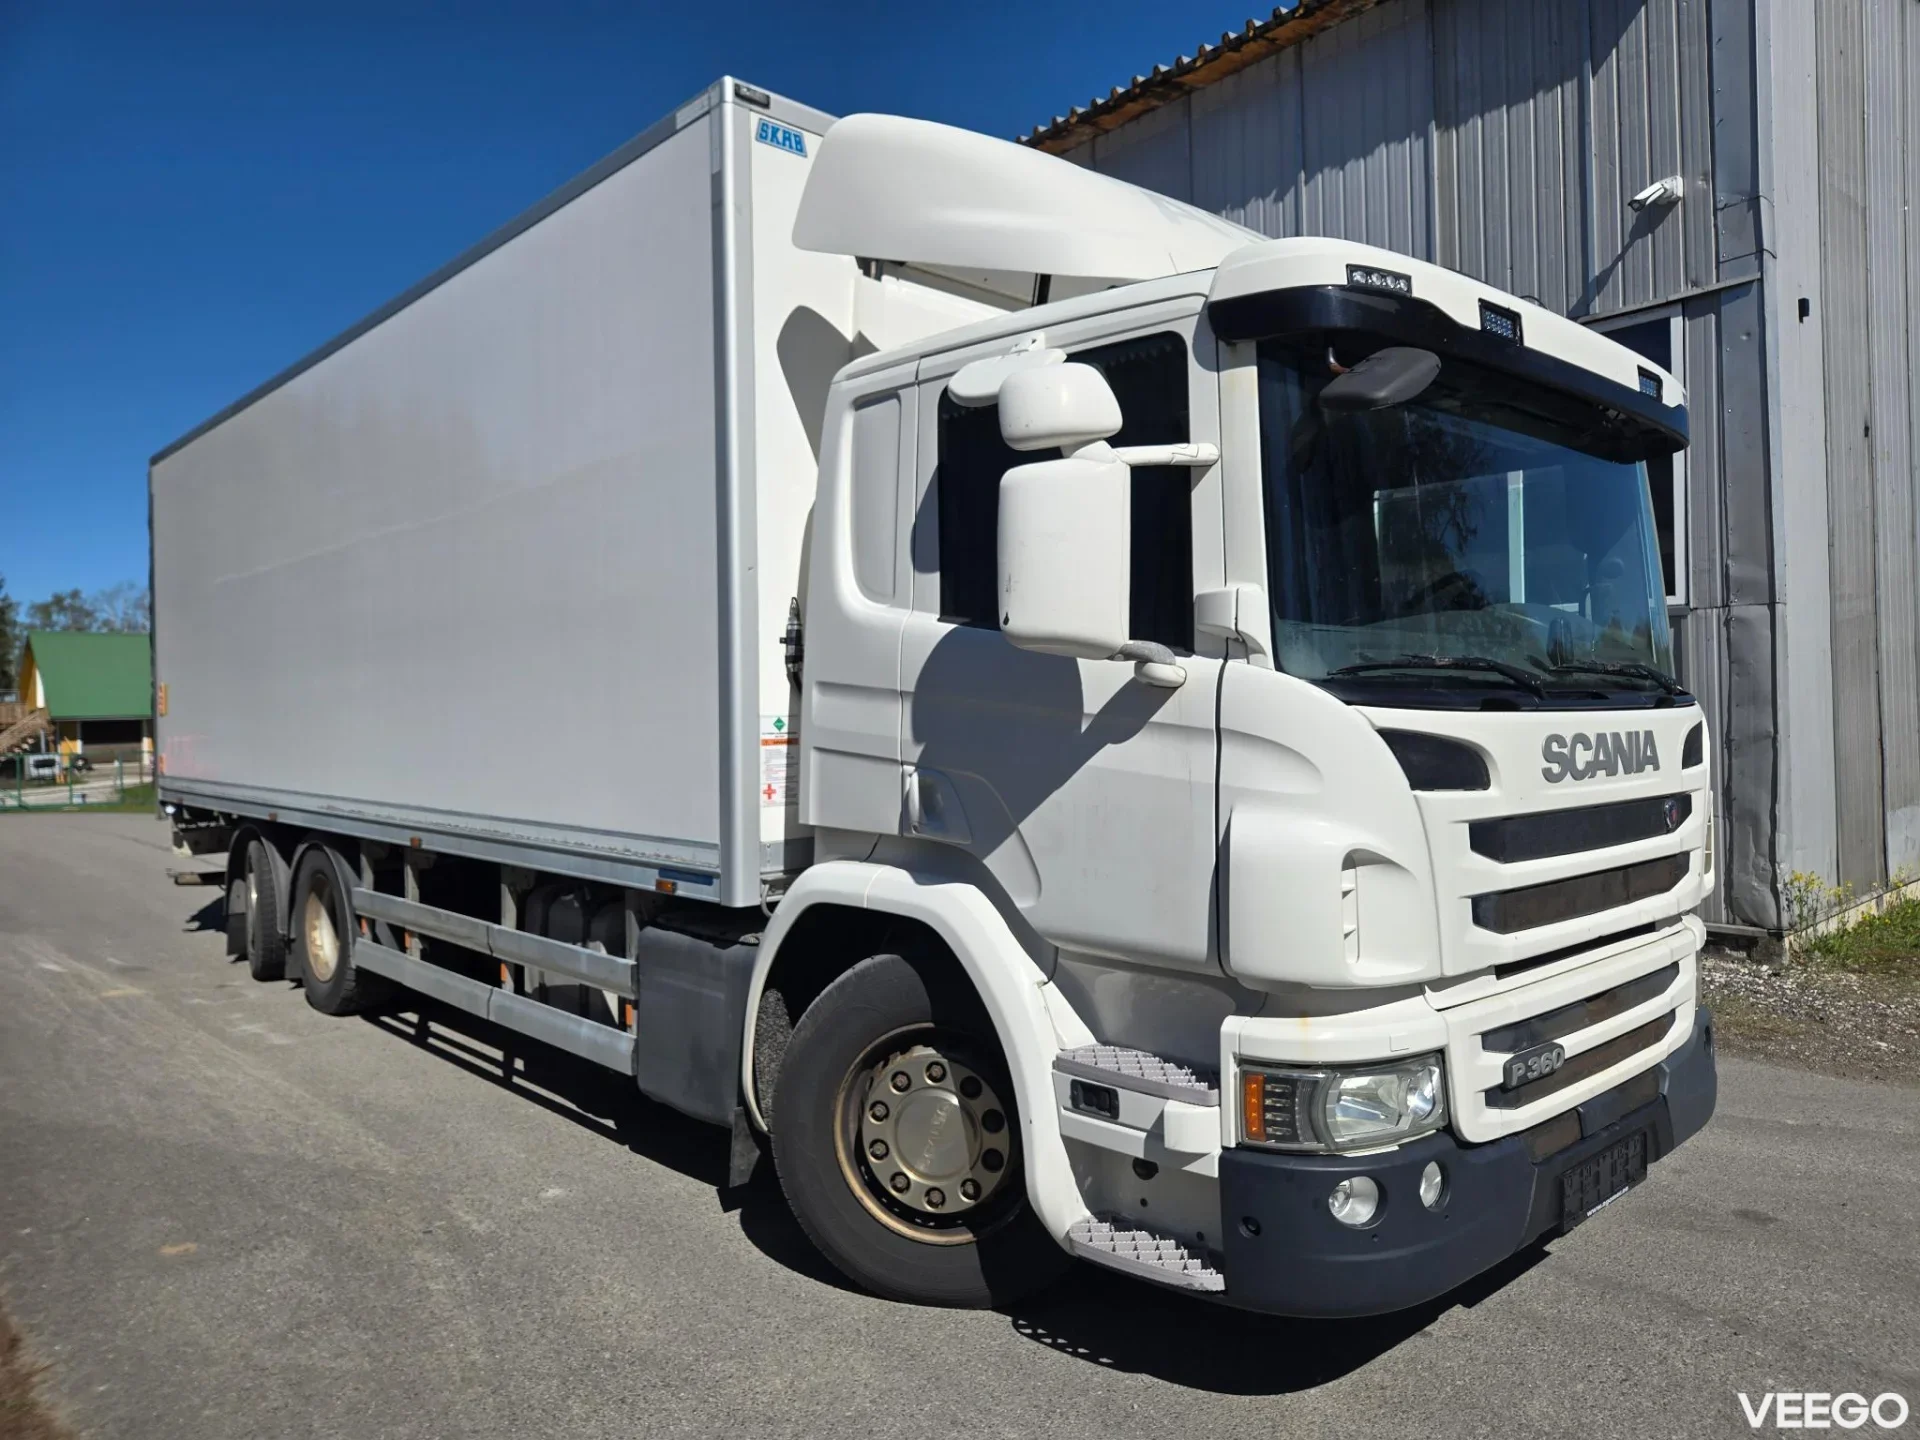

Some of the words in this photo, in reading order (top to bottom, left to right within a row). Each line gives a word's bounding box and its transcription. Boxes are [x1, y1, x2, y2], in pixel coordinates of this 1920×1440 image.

[759, 122, 804, 153] SKAB
[1541, 730, 1660, 783] SCANIA
[1527, 1048, 1565, 1079] 360
